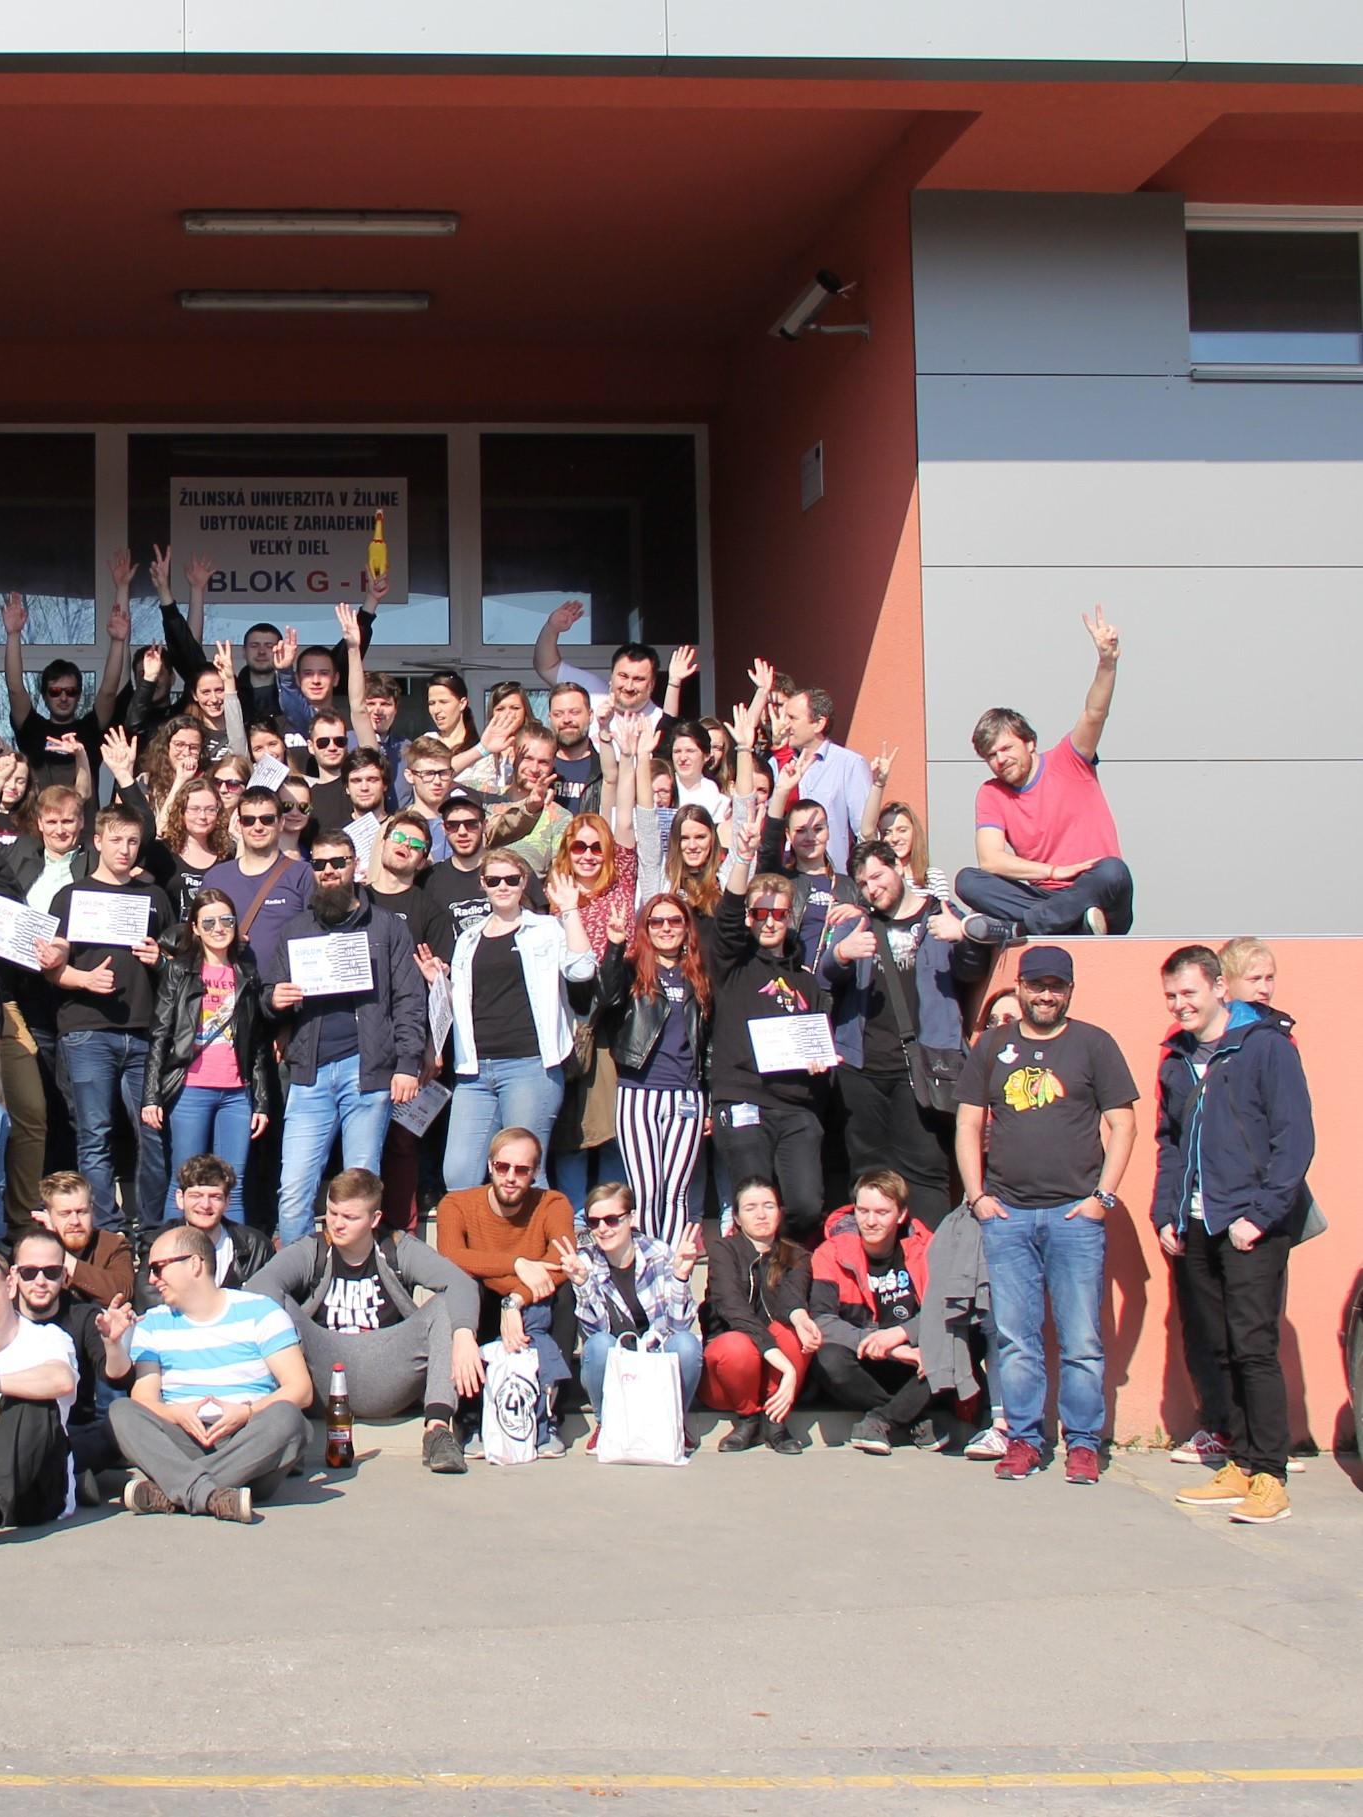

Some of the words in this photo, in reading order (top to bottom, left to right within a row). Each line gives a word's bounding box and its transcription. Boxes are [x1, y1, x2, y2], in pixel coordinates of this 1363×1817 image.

[179, 487, 245, 507] ŽILINSKÁ
[250, 490, 332, 507] UNIVERZITA
[339, 491, 349, 507] V
[353, 487, 399, 507] ŽILINE
[200, 514, 289, 531] UBYTOVACIE
[249, 536, 293, 556] VEĽKÝ
[298, 539, 330, 556] DIEL
[207, 570, 296, 593] BLOK
[306, 569, 329, 593] G
